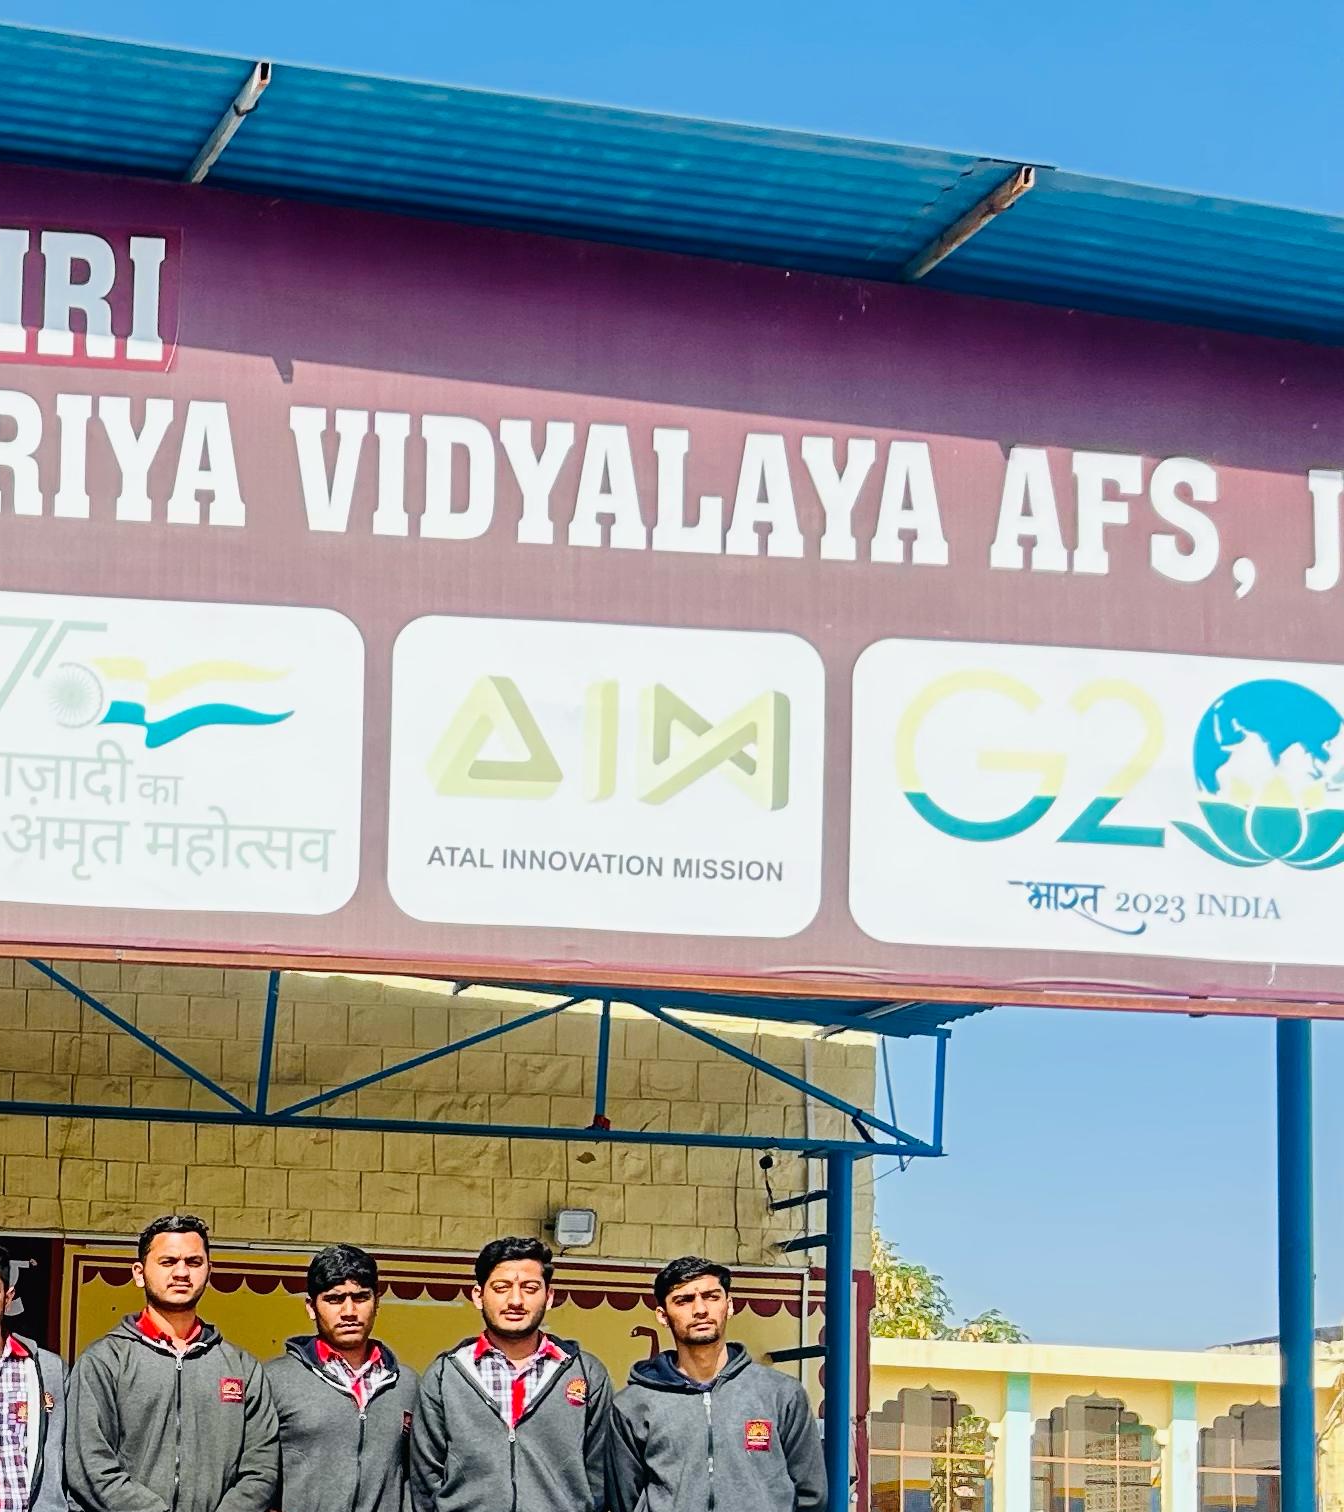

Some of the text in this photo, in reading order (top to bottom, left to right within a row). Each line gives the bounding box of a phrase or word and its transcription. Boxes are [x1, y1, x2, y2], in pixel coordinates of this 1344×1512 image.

[289, 406, 950, 567] VIDYALAYA
[991, 445, 1256, 599] AFS,
[136, 773, 184, 806] का
[1, 805, 337, 881] अमृत महोत्सव
[427, 845, 784, 882] ATAL INNOVATION MISSION
[1115, 892, 1186, 923] 2023
[1197, 893, 1281, 920] INDIA
